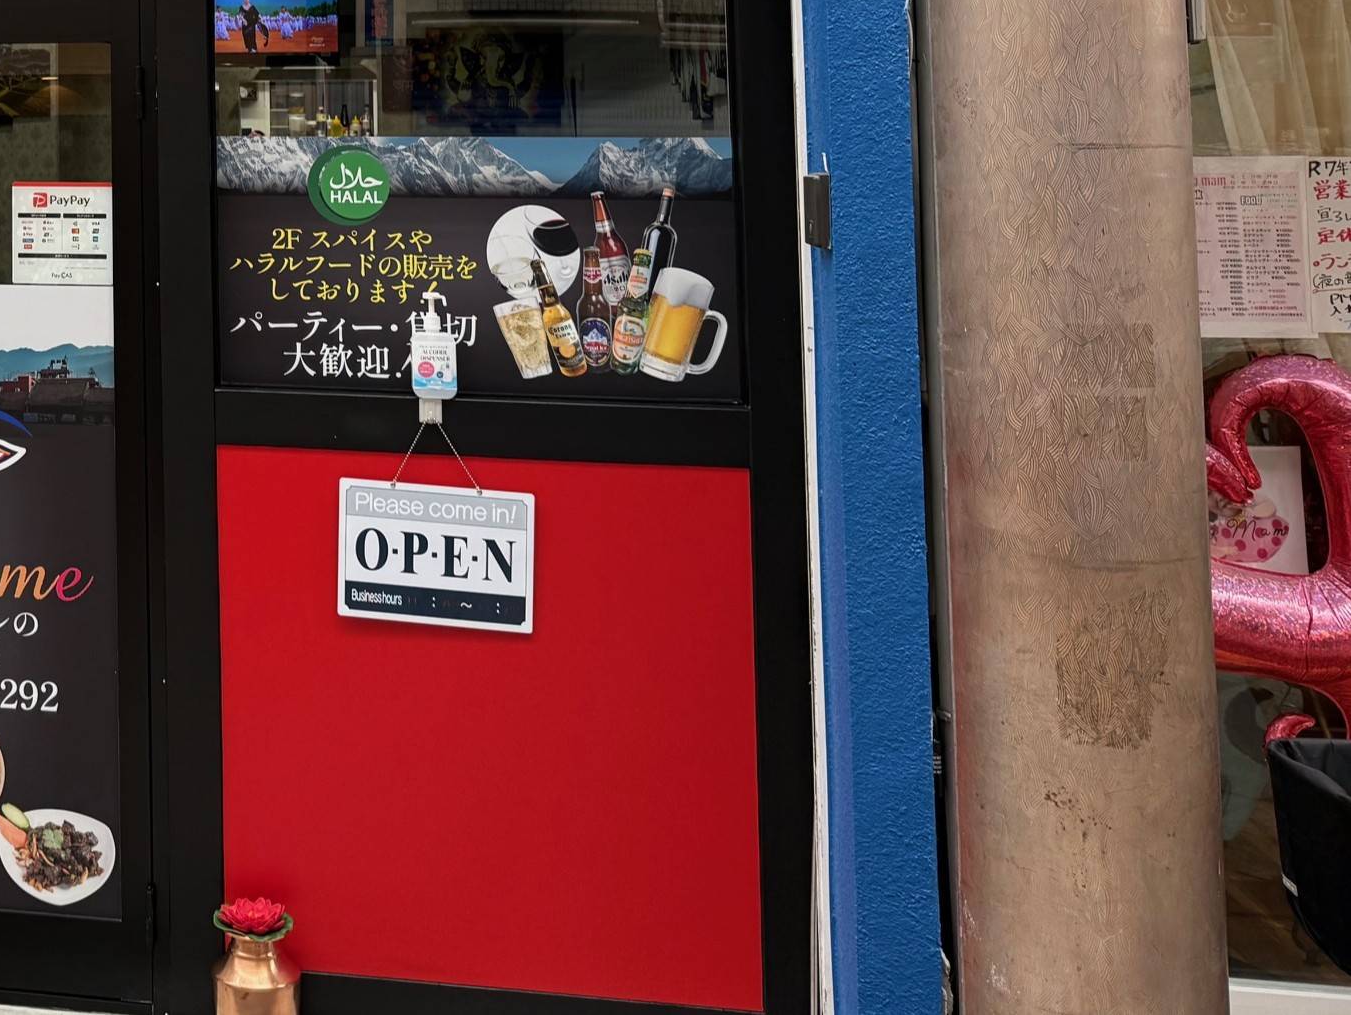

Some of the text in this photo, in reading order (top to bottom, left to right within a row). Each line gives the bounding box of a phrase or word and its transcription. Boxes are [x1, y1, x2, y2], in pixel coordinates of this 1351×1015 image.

[329, 162, 384, 190] حلال
[49, 194, 91, 207] PayPay
[330, 189, 384, 204] HALAL
[272, 228, 433, 253] 2F スパイスや
[229, 251, 477, 281] ハラルフードの販売を
[354, 491, 517, 524] Please come in!
